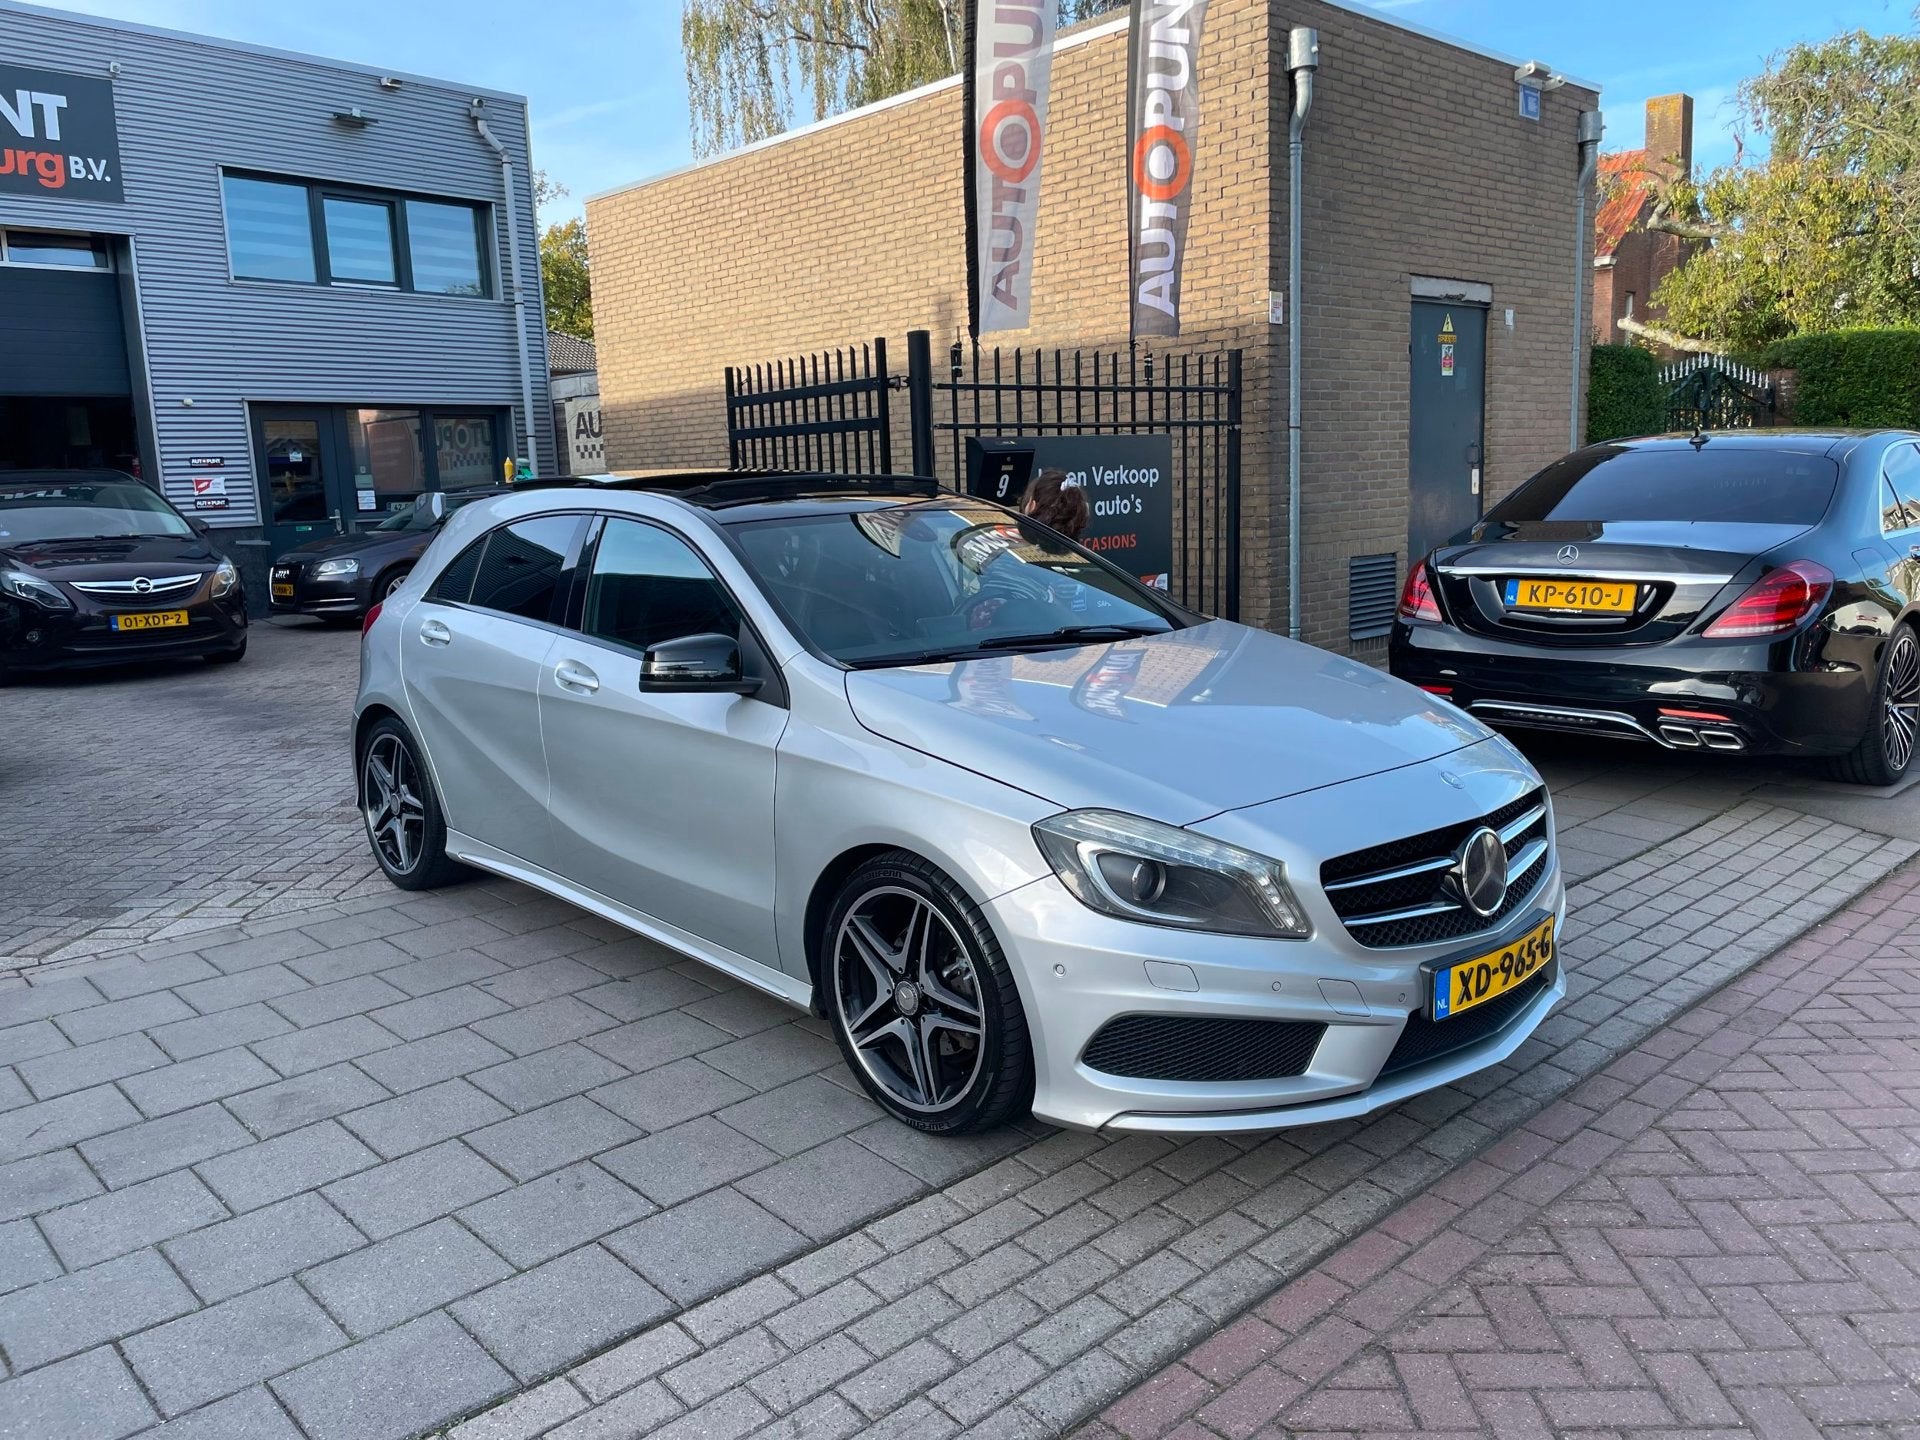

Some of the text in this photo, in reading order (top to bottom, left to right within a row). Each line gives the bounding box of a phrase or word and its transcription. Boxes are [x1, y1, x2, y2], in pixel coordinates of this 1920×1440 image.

[979, 0, 1045, 311] AUTOPU
[69, 156, 111, 182] B.V.
[996, 474, 1010, 498] 9
[1092, 464, 1160, 488] Verkoop
[1094, 494, 1143, 516] auto's
[1080, 533, 1137, 551] CASIONS
[1528, 585, 1624, 607] KP-610-J
[124, 613, 183, 628] 01-XDP-2
[1437, 925, 1551, 1011] NL XD-965-G
